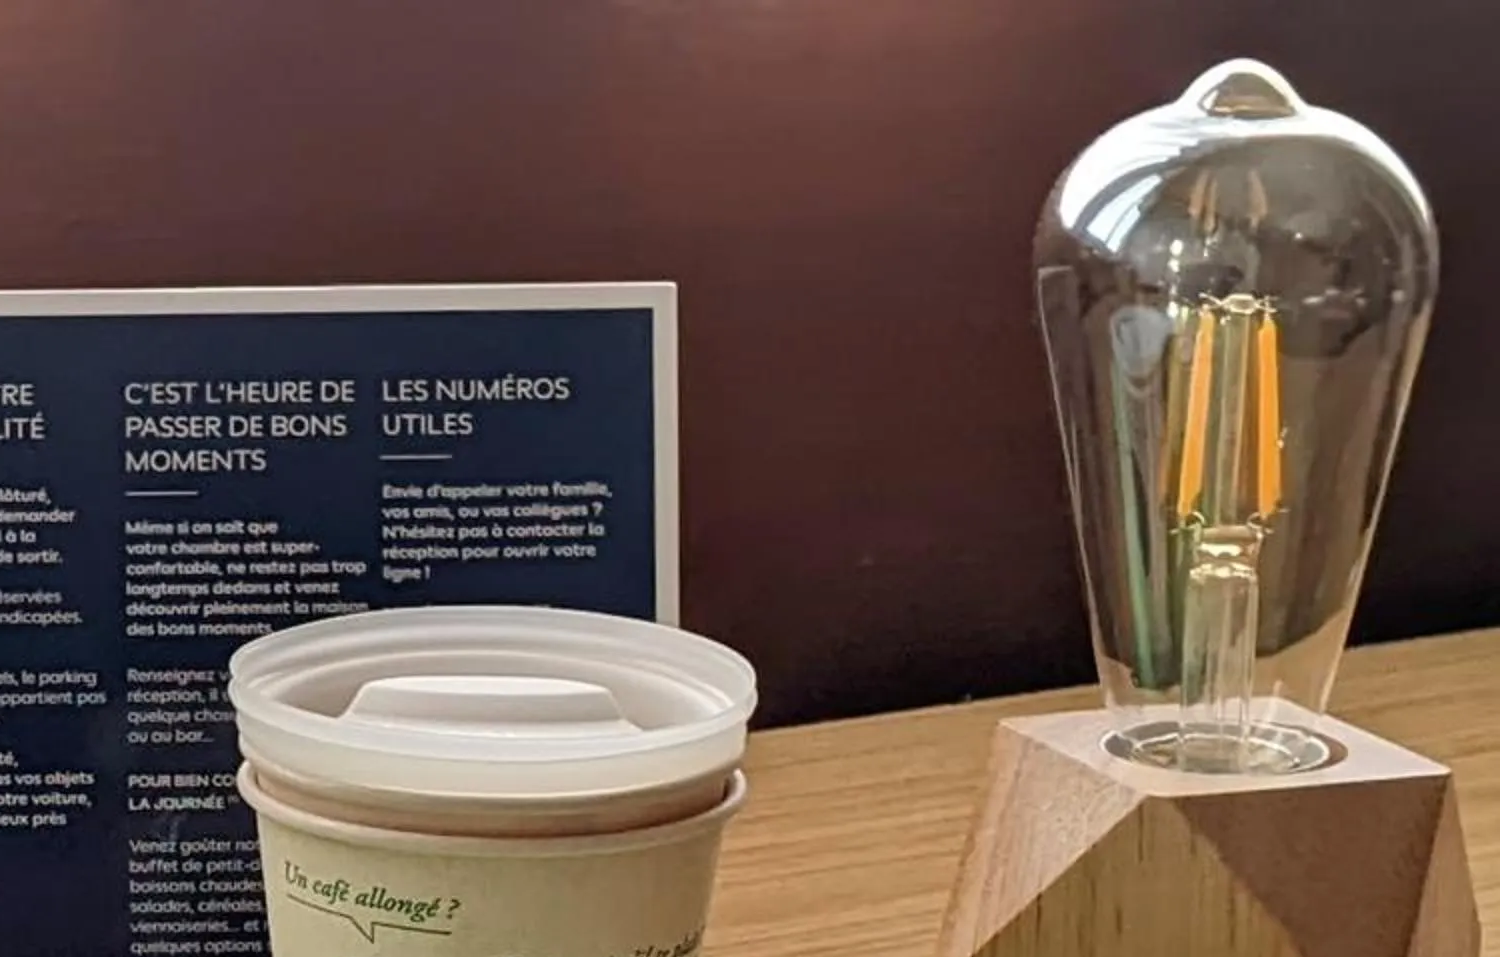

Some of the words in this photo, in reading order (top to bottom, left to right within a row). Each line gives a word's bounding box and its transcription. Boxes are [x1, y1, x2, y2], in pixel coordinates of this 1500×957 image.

[125, 382, 198, 405] C'EST
[206, 381, 312, 403] L'HEURE
[321, 380, 354, 403] DE
[383, 379, 428, 402] LES
[436, 374, 569, 401] NUMÉROS
[126, 416, 221, 438] PASSER
[229, 415, 262, 437] DE
[272, 415, 346, 437] BONS
[383, 413, 472, 435] UTILES
[126, 449, 266, 472] MOMENTS
[382, 484, 424, 499] Envie
[506, 485, 549, 496] votre
[381, 508, 410, 519] vos
[458, 508, 479, 518] ou
[483, 506, 510, 517] vos
[214, 520, 245, 534] sait
[247, 523, 279, 535] que
[458, 527, 488, 540] pas
[506, 525, 585, 537] contacter
[587, 522, 605, 536] la
[125, 542, 167, 555] votre
[171, 541, 240, 554] chambre
[243, 542, 267, 555] est
[382, 545, 459, 562] réception
[461, 547, 500, 560] pour
[503, 544, 550, 557] ouvrir
[553, 543, 597, 557] votre
[16, 550, 63, 563] sortir.
[249, 562, 296, 573] restez
[300, 562, 330, 576] pas
[331, 561, 367, 575] trop
[125, 581, 209, 598] longtemps
[212, 581, 271, 595] dedans
[294, 582, 340, 594] venez
[125, 601, 200, 616] découvrir
[204, 600, 291, 617] pleinement
[127, 621, 154, 636] des
[158, 621, 195, 636] bons
[38, 671, 97, 688] parking
[76, 693, 107, 706] pas
[126, 709, 191, 725] quelque
[126, 732, 149, 743] ou
[14, 774, 43, 784] vos
[44, 771, 95, 789] objets
[127, 774, 171, 788] POUR
[31, 791, 92, 808] voiture,
[128, 798, 151, 810] LA
[153, 794, 225, 811] JOURNÉE
[31, 811, 67, 827] près
[129, 839, 176, 854] Venez
[128, 858, 178, 873] buffet
[182, 859, 202, 872] de
[128, 879, 196, 894] boissons
[284, 860, 308, 889] Un
[312, 879, 351, 905] café
[355, 886, 442, 922] allongé
[446, 898, 462, 919] ?
